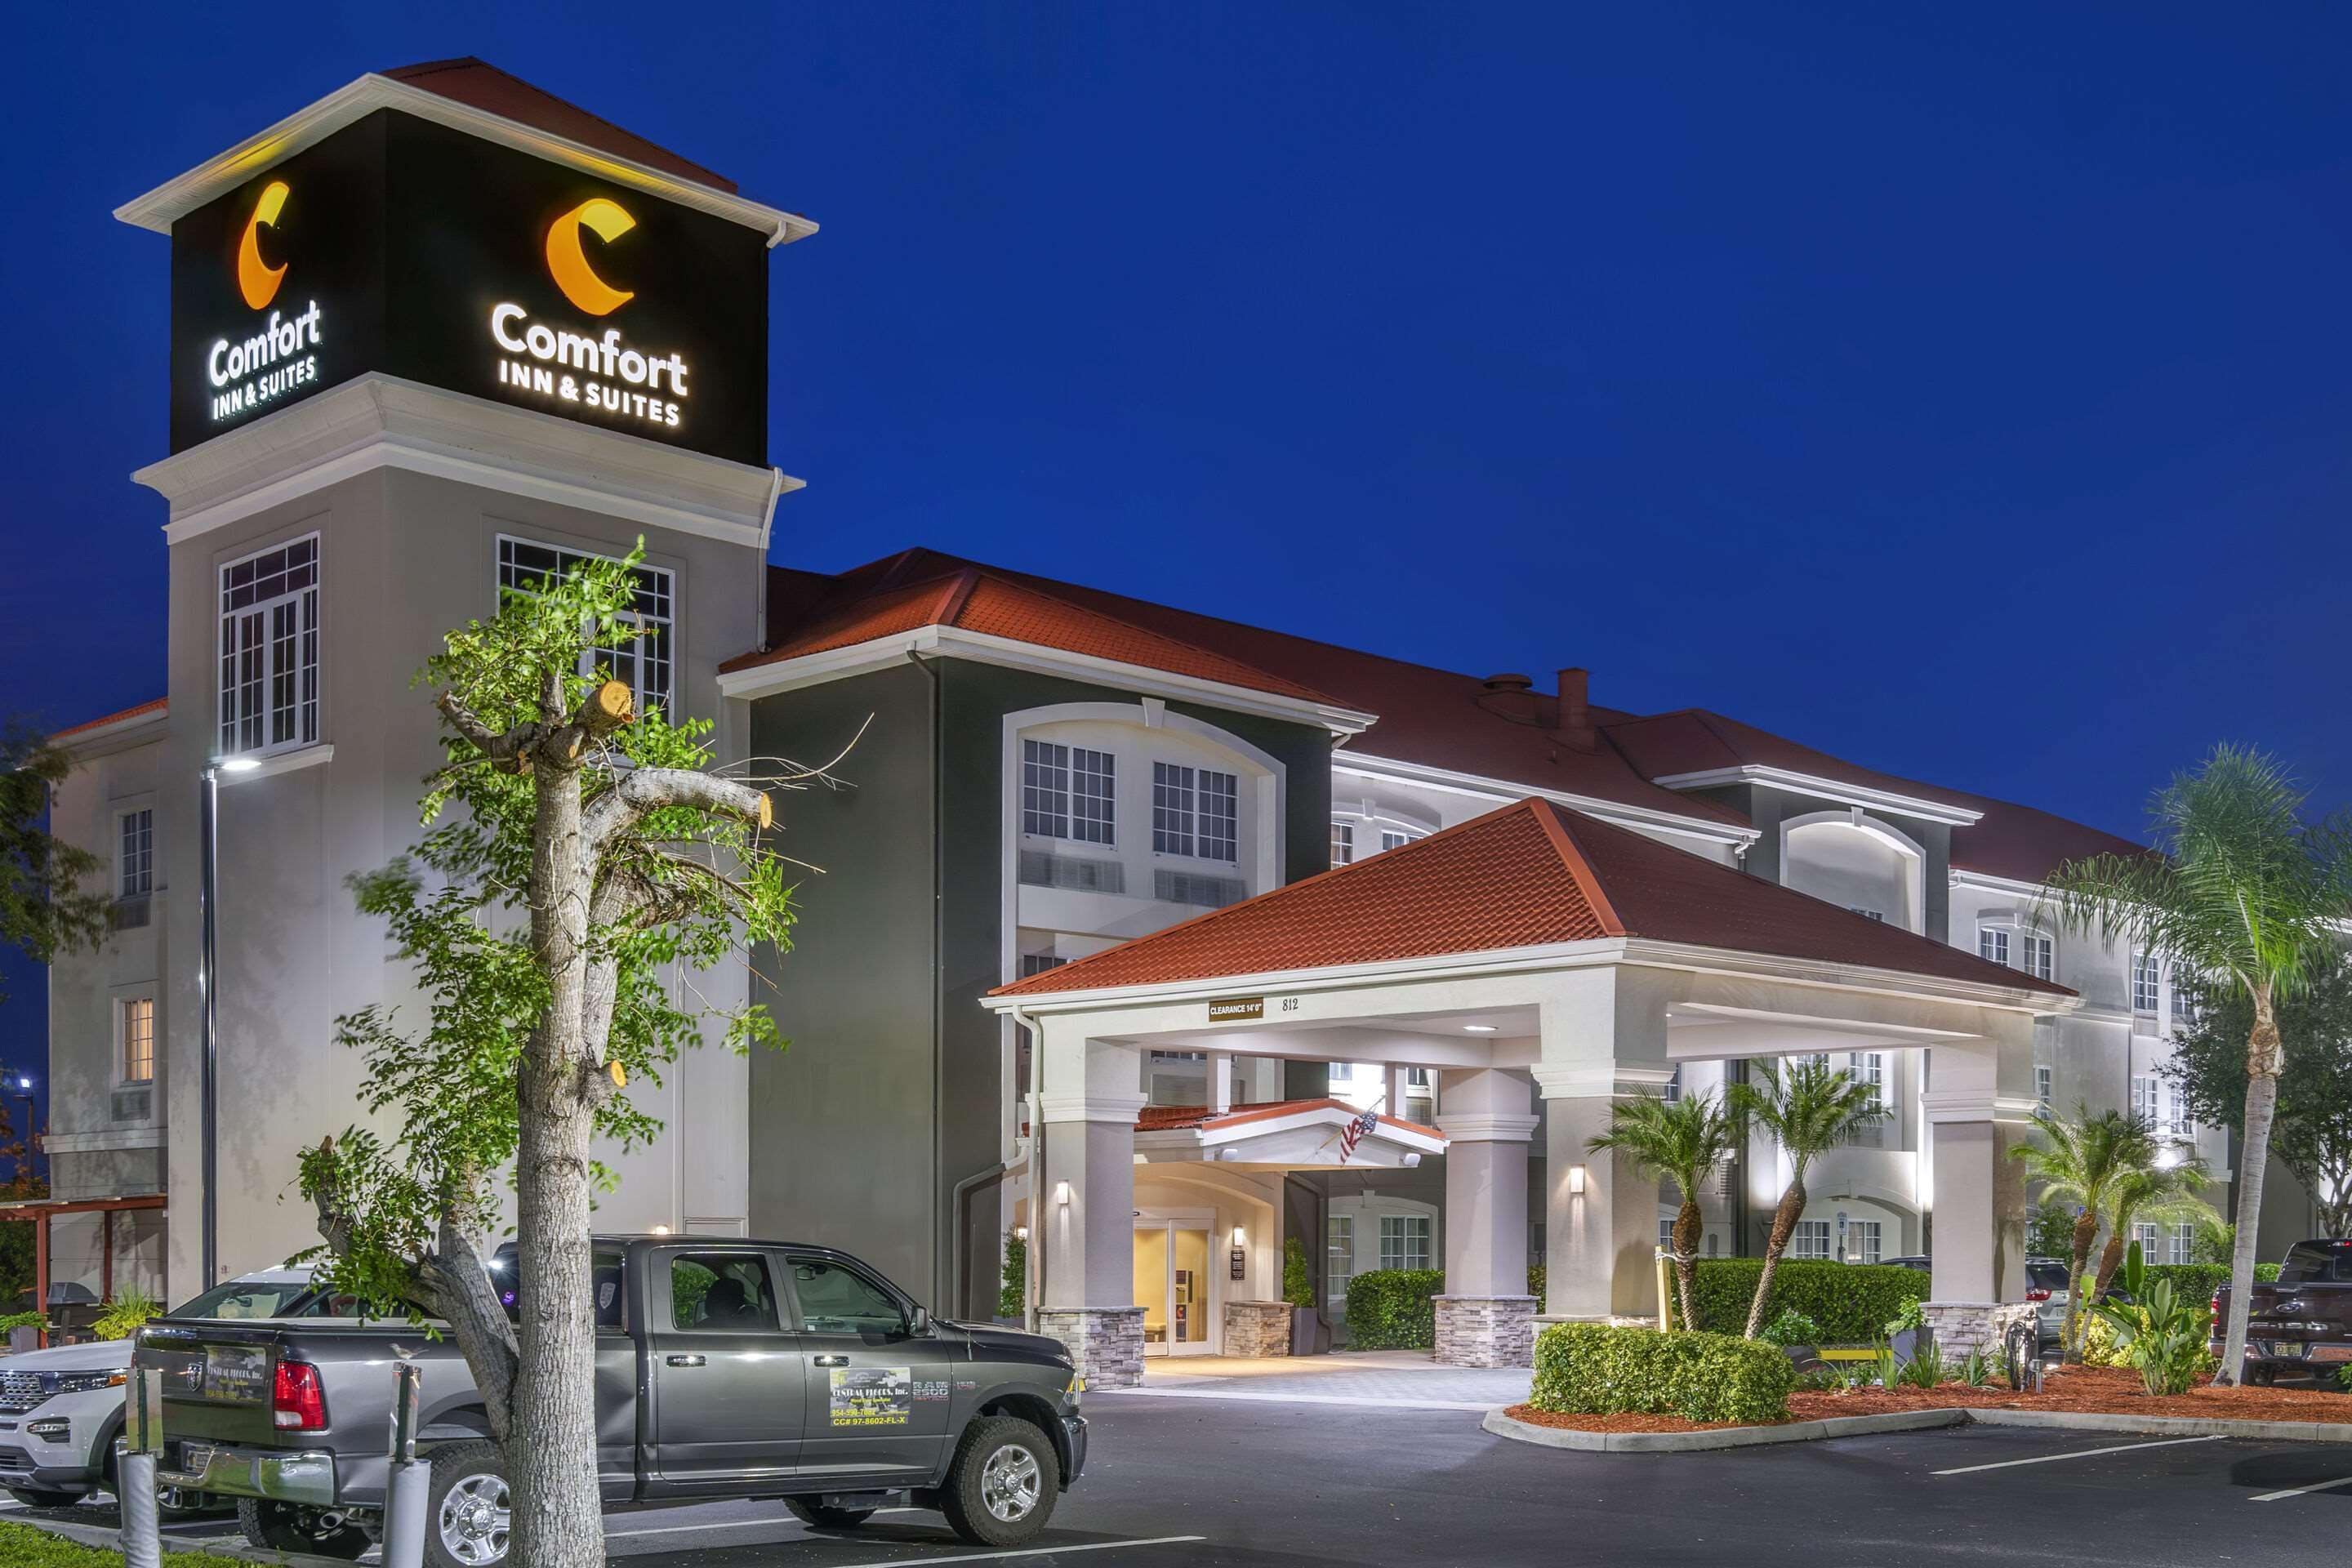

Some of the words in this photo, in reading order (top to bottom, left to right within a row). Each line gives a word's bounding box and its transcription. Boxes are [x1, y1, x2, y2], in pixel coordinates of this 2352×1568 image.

[210, 300, 320, 386] Comfort
[492, 303, 688, 396] Comfort
[213, 388, 243, 420] INN
[245, 382, 256, 406] &
[259, 355, 315, 400] SUITES
[500, 359, 553, 394] INN
[559, 376, 580, 402] &
[586, 381, 679, 425] SUITES
[1209, 1004, 1245, 1015] CLEARANCE
[1282, 998, 1298, 1011] 812
[895, 1388, 909, 1396] Inc.
